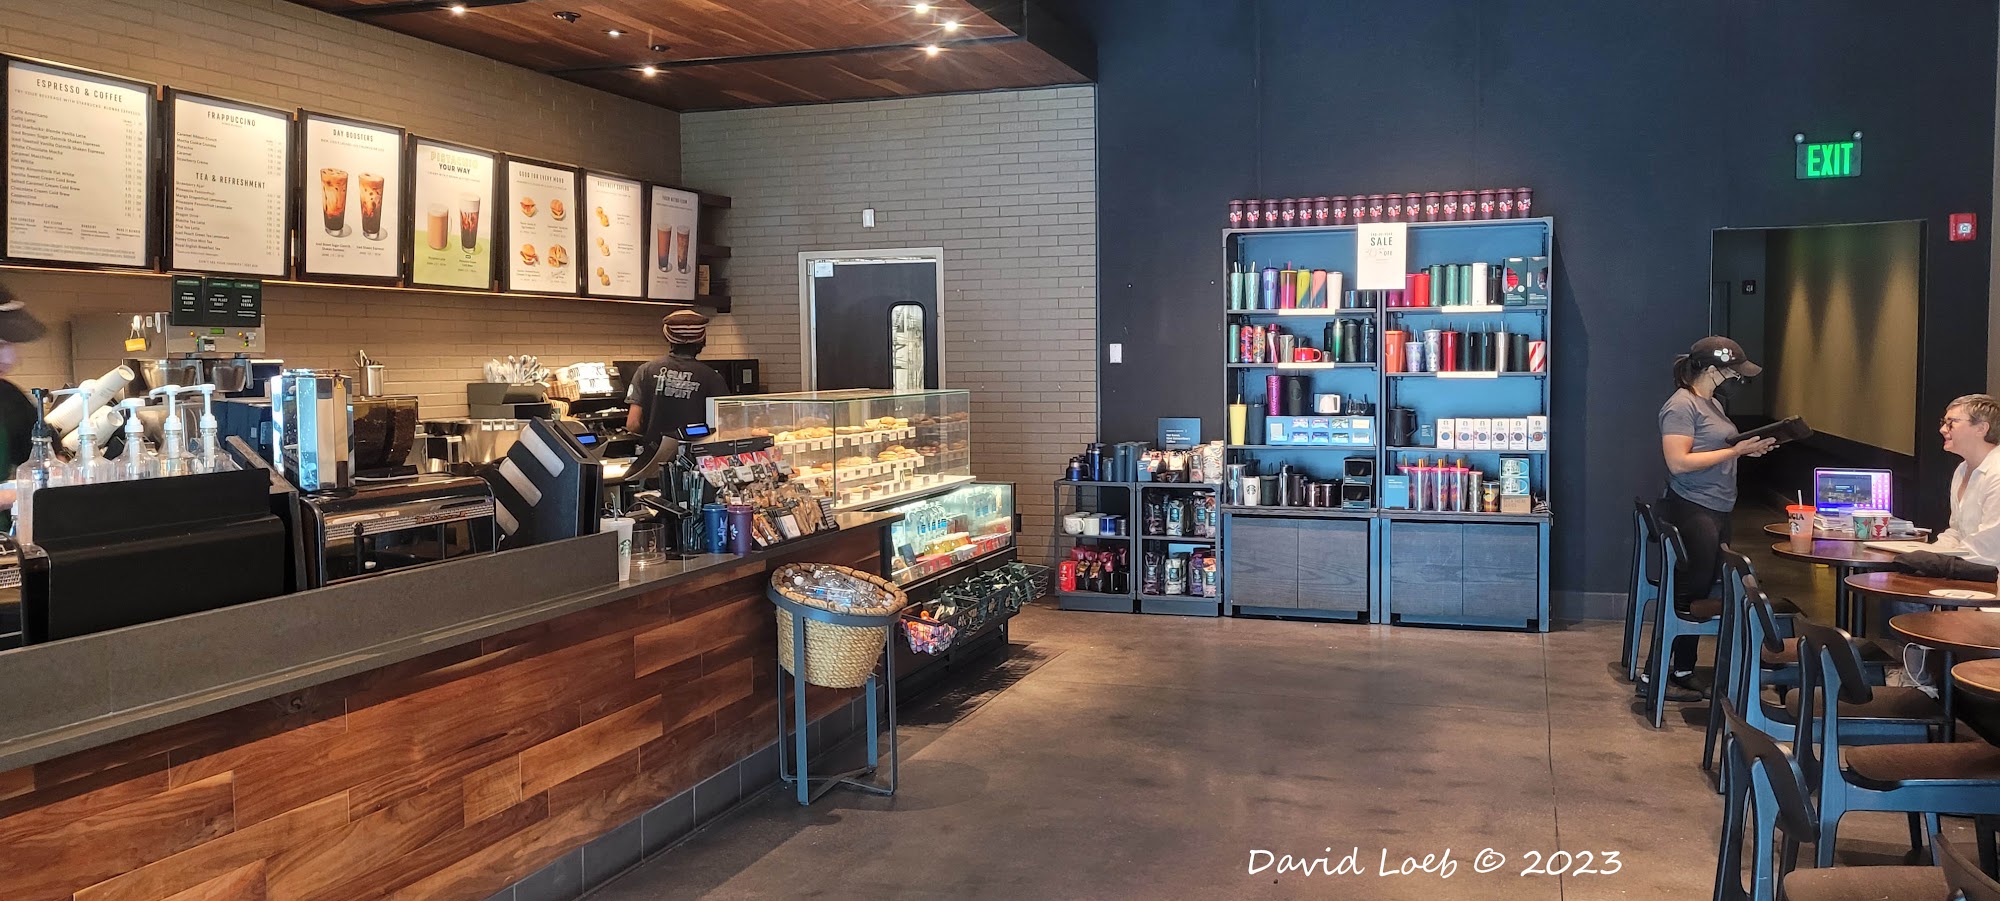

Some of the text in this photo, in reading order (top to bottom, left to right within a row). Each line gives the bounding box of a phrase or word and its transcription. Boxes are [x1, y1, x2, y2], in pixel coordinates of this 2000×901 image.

[36, 78, 123, 103] ESPRESSO & COFFEE
[207, 111, 256, 127] FRAPPUCCINO
[333, 129, 373, 142] DAY BOOSTERS
[430, 151, 479, 169] PISTACHIO
[1807, 143, 1854, 176] EXIT
[439, 163, 471, 175] YOUR WAY
[195, 172, 266, 189] TEA & REFRESHMENT
[1370, 237, 1393, 247] SALE
[667, 370, 693, 381] CRAFT
